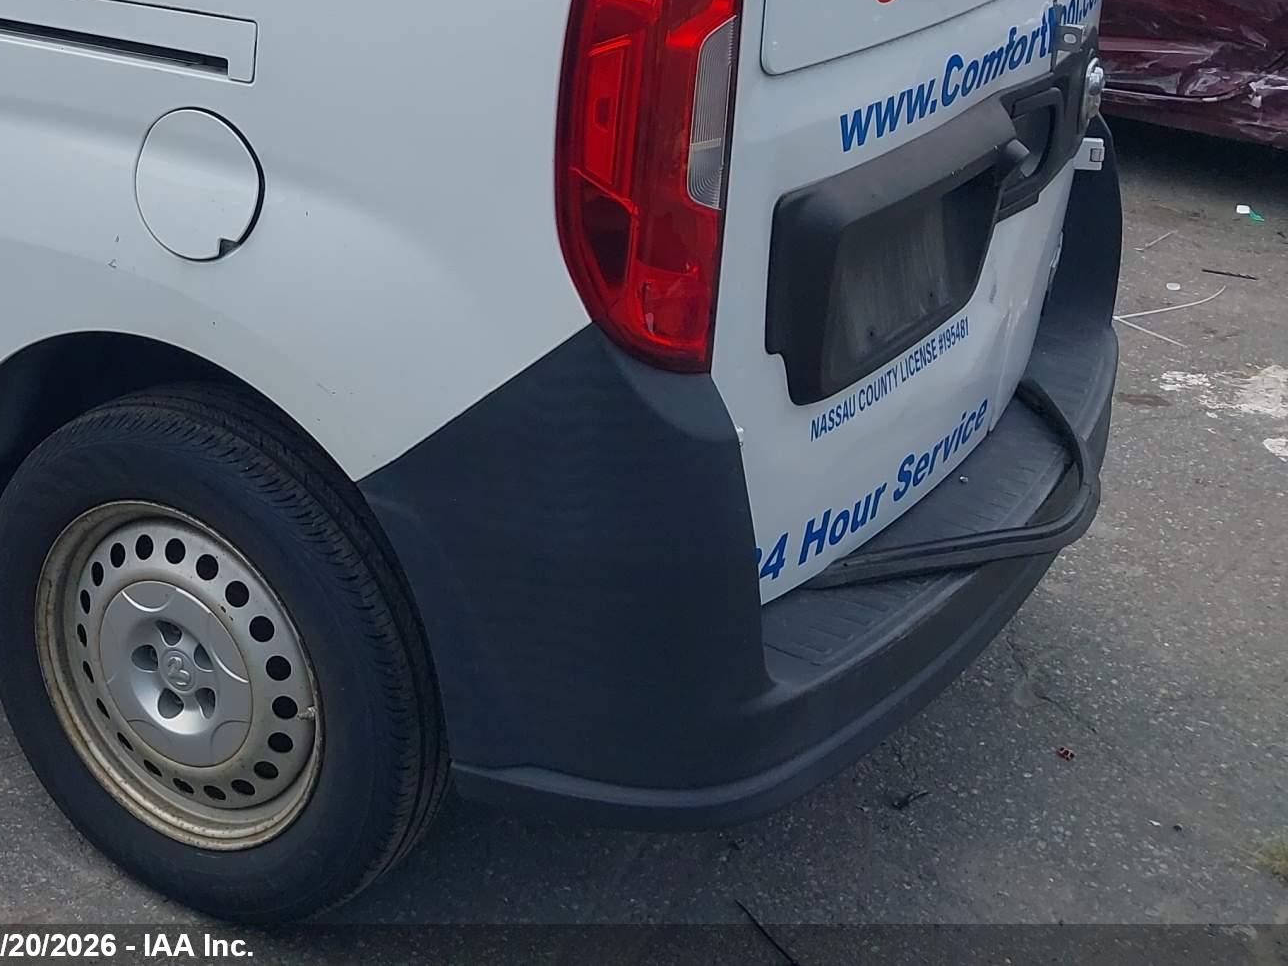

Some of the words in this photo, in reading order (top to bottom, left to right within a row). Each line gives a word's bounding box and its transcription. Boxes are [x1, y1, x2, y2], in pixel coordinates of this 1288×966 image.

[810, 394, 856, 442] NASSAU
[859, 365, 898, 411] COUNTY
[900, 338, 938, 382] LICENSE
[798, 483, 887, 565] Hour
[893, 398, 988, 503] Service
